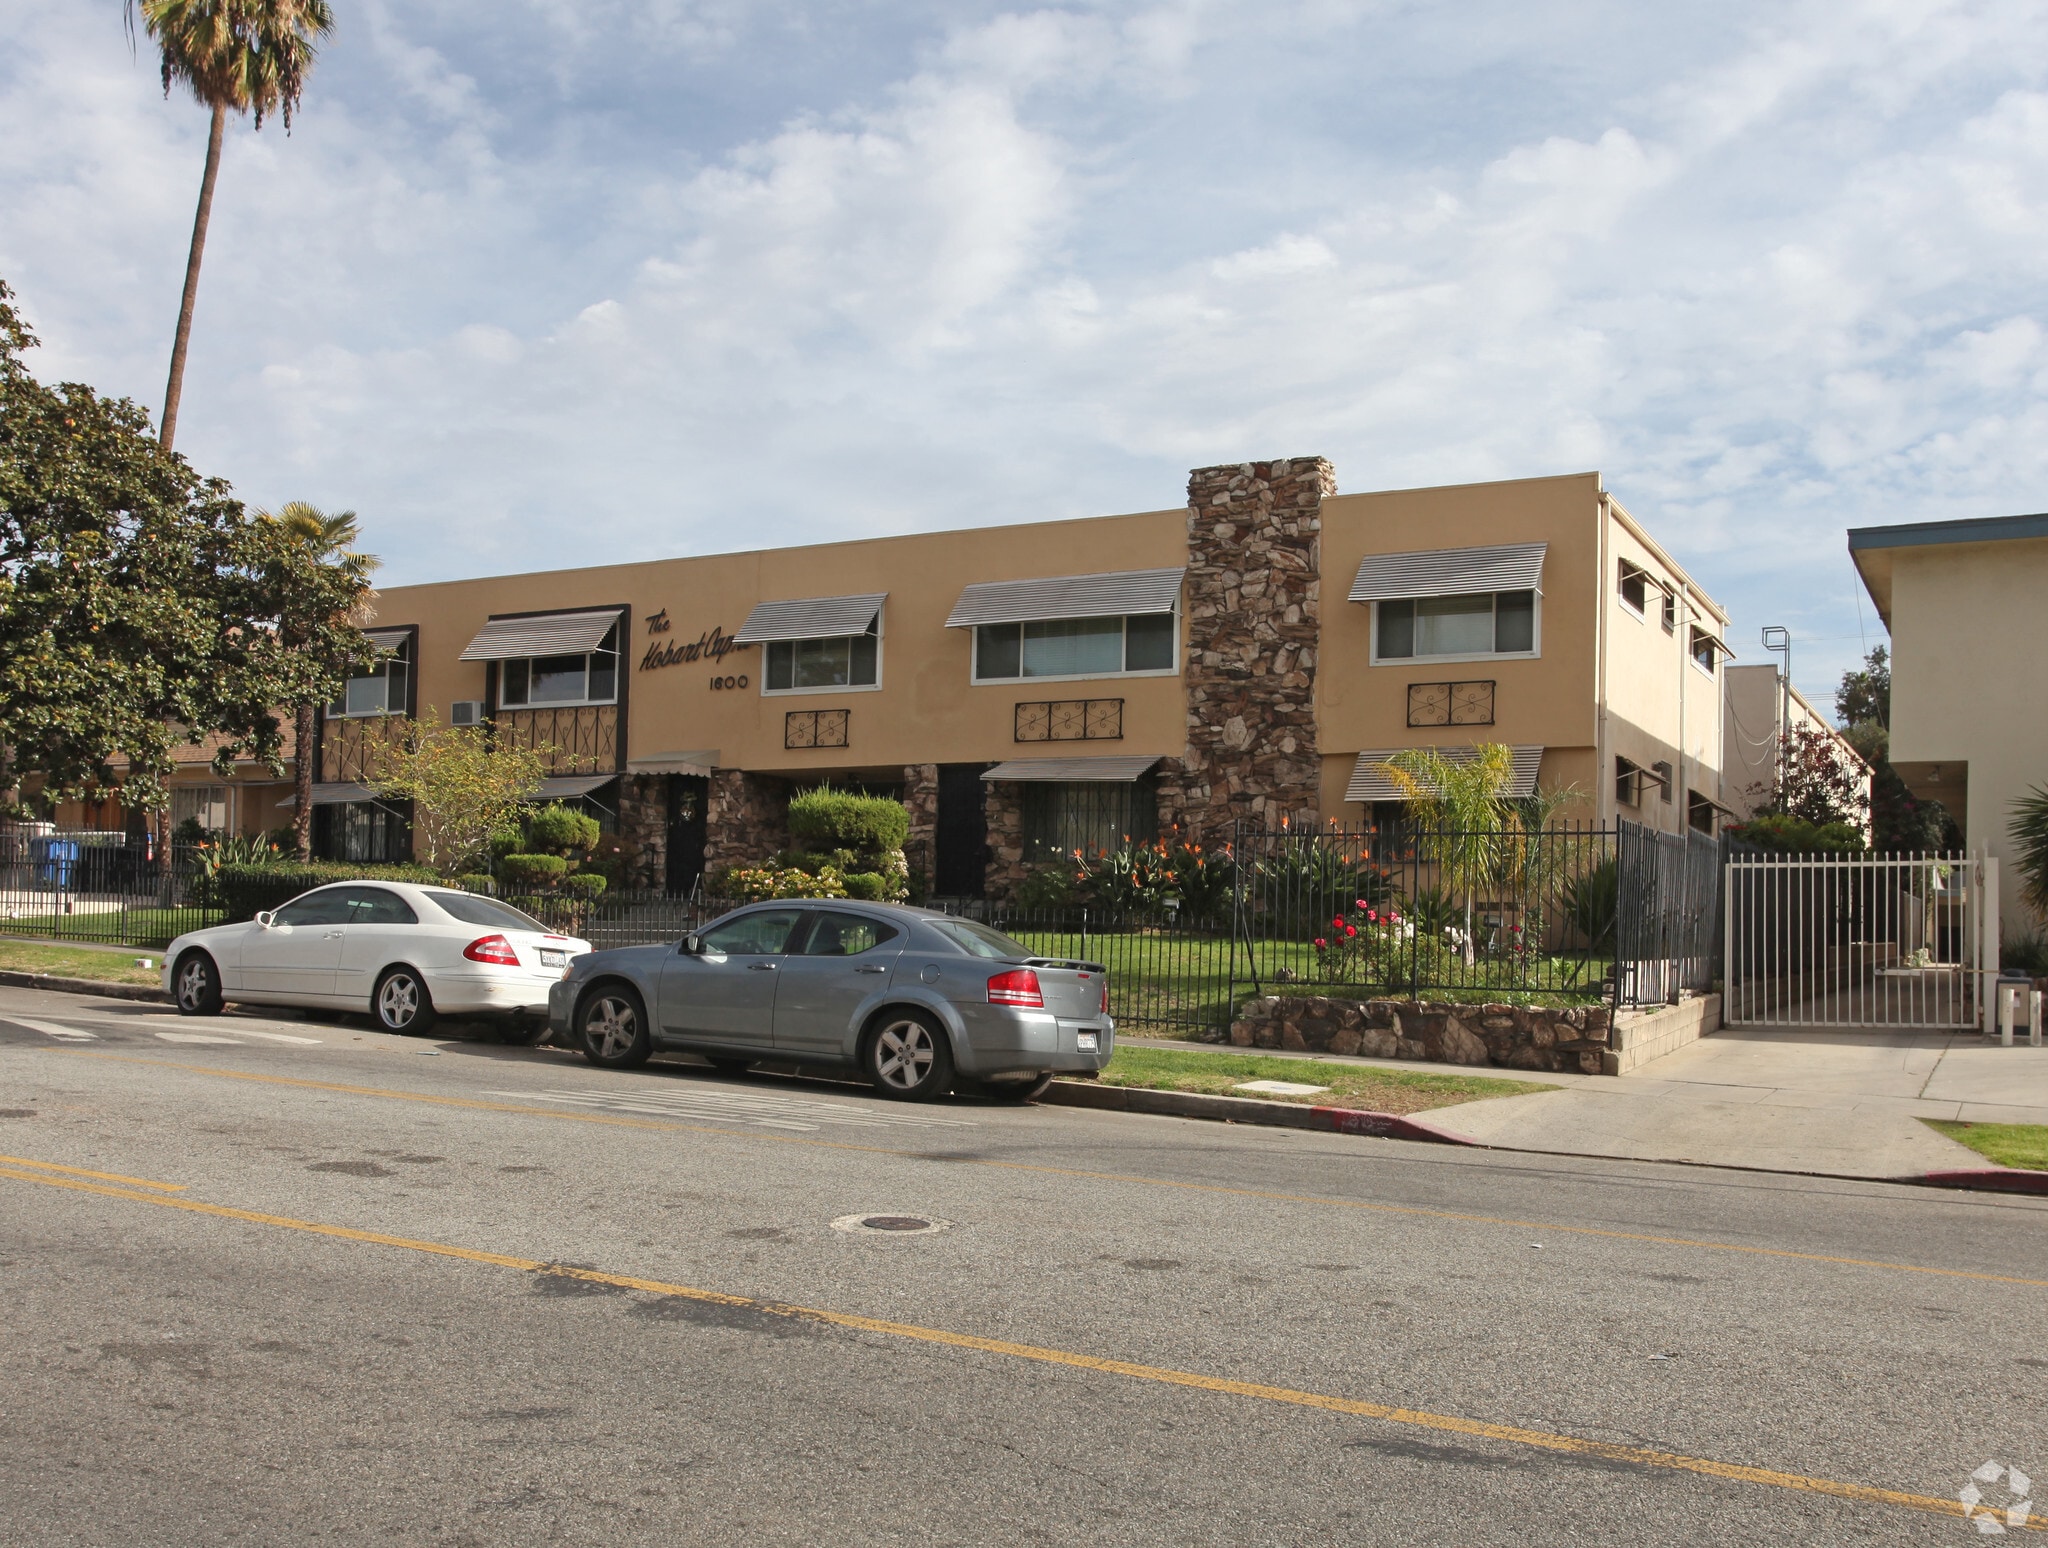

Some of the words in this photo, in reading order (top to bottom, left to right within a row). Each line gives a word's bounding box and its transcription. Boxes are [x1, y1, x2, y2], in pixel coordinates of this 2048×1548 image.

[645, 608, 670, 635] The
[639, 631, 706, 672] Hobart
[709, 675, 748, 690] 1600
